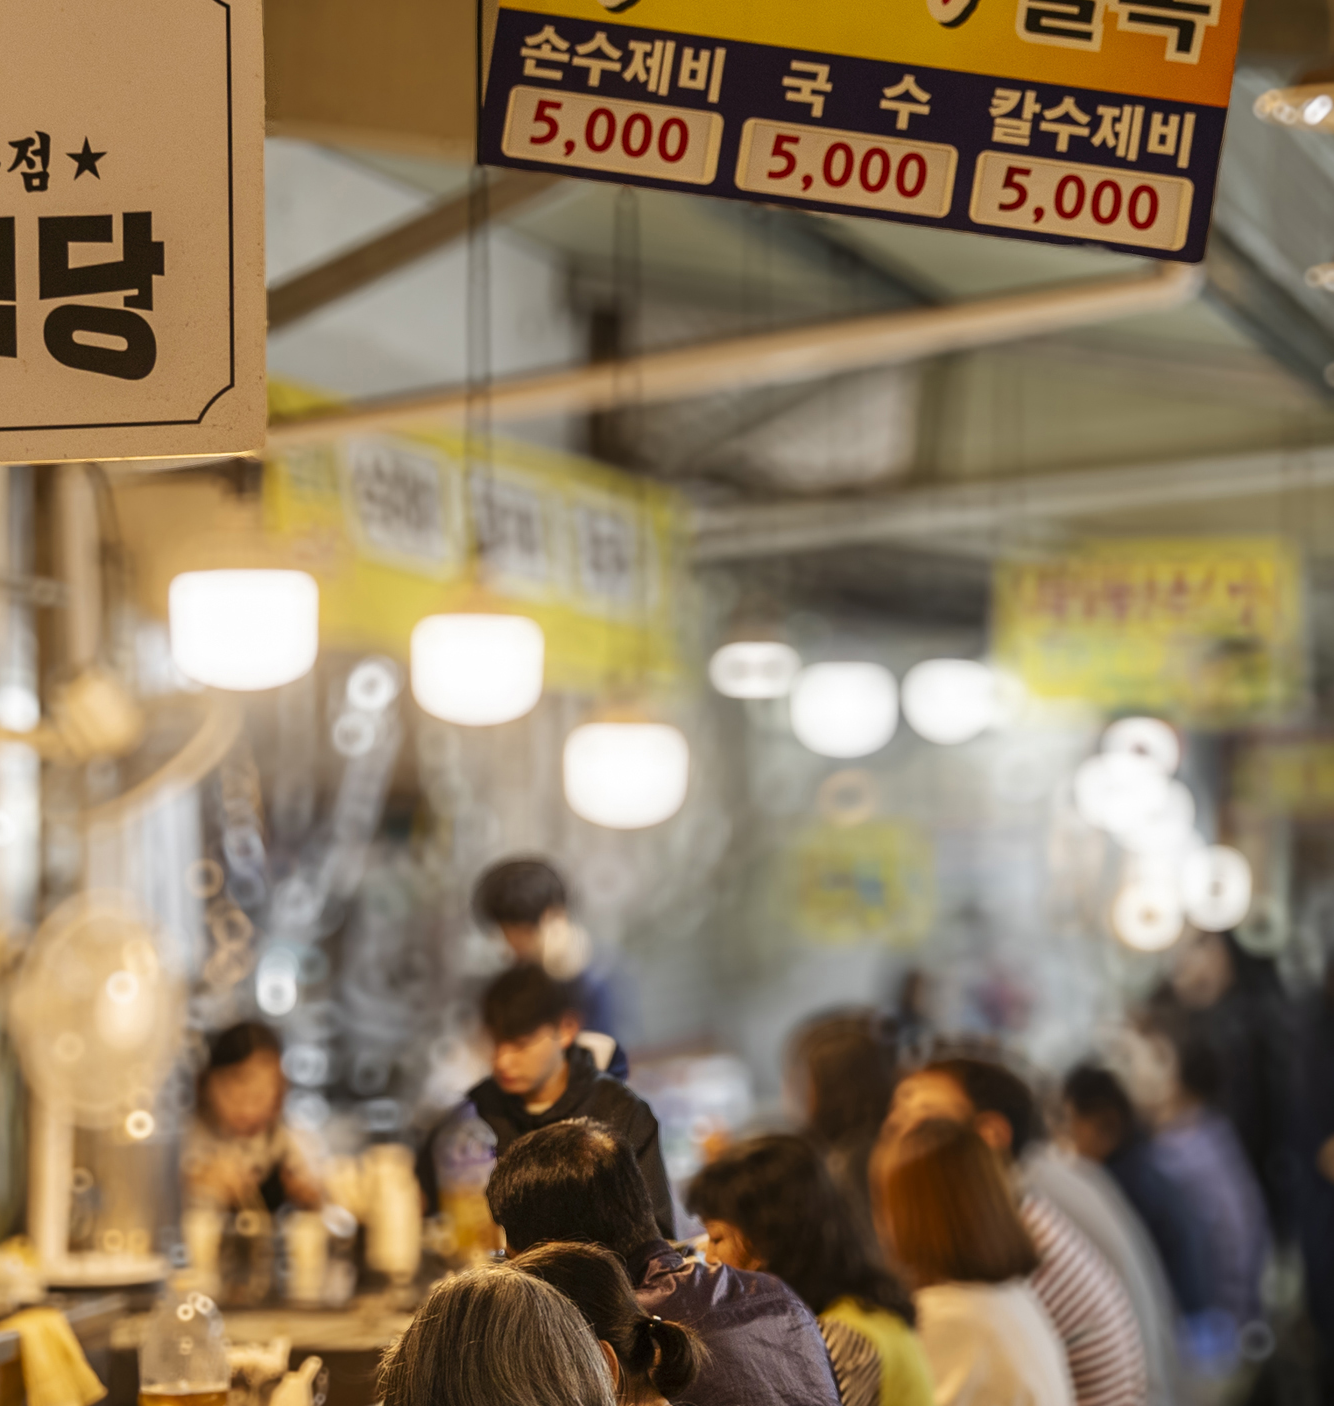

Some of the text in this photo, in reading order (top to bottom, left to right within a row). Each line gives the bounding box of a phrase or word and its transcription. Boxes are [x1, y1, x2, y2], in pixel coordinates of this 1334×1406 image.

[520, 24, 727, 104] 손수제비
[990, 87, 1197, 169] 칼수제비
[528, 99, 1159, 231] 5,000 5,000 5,000
